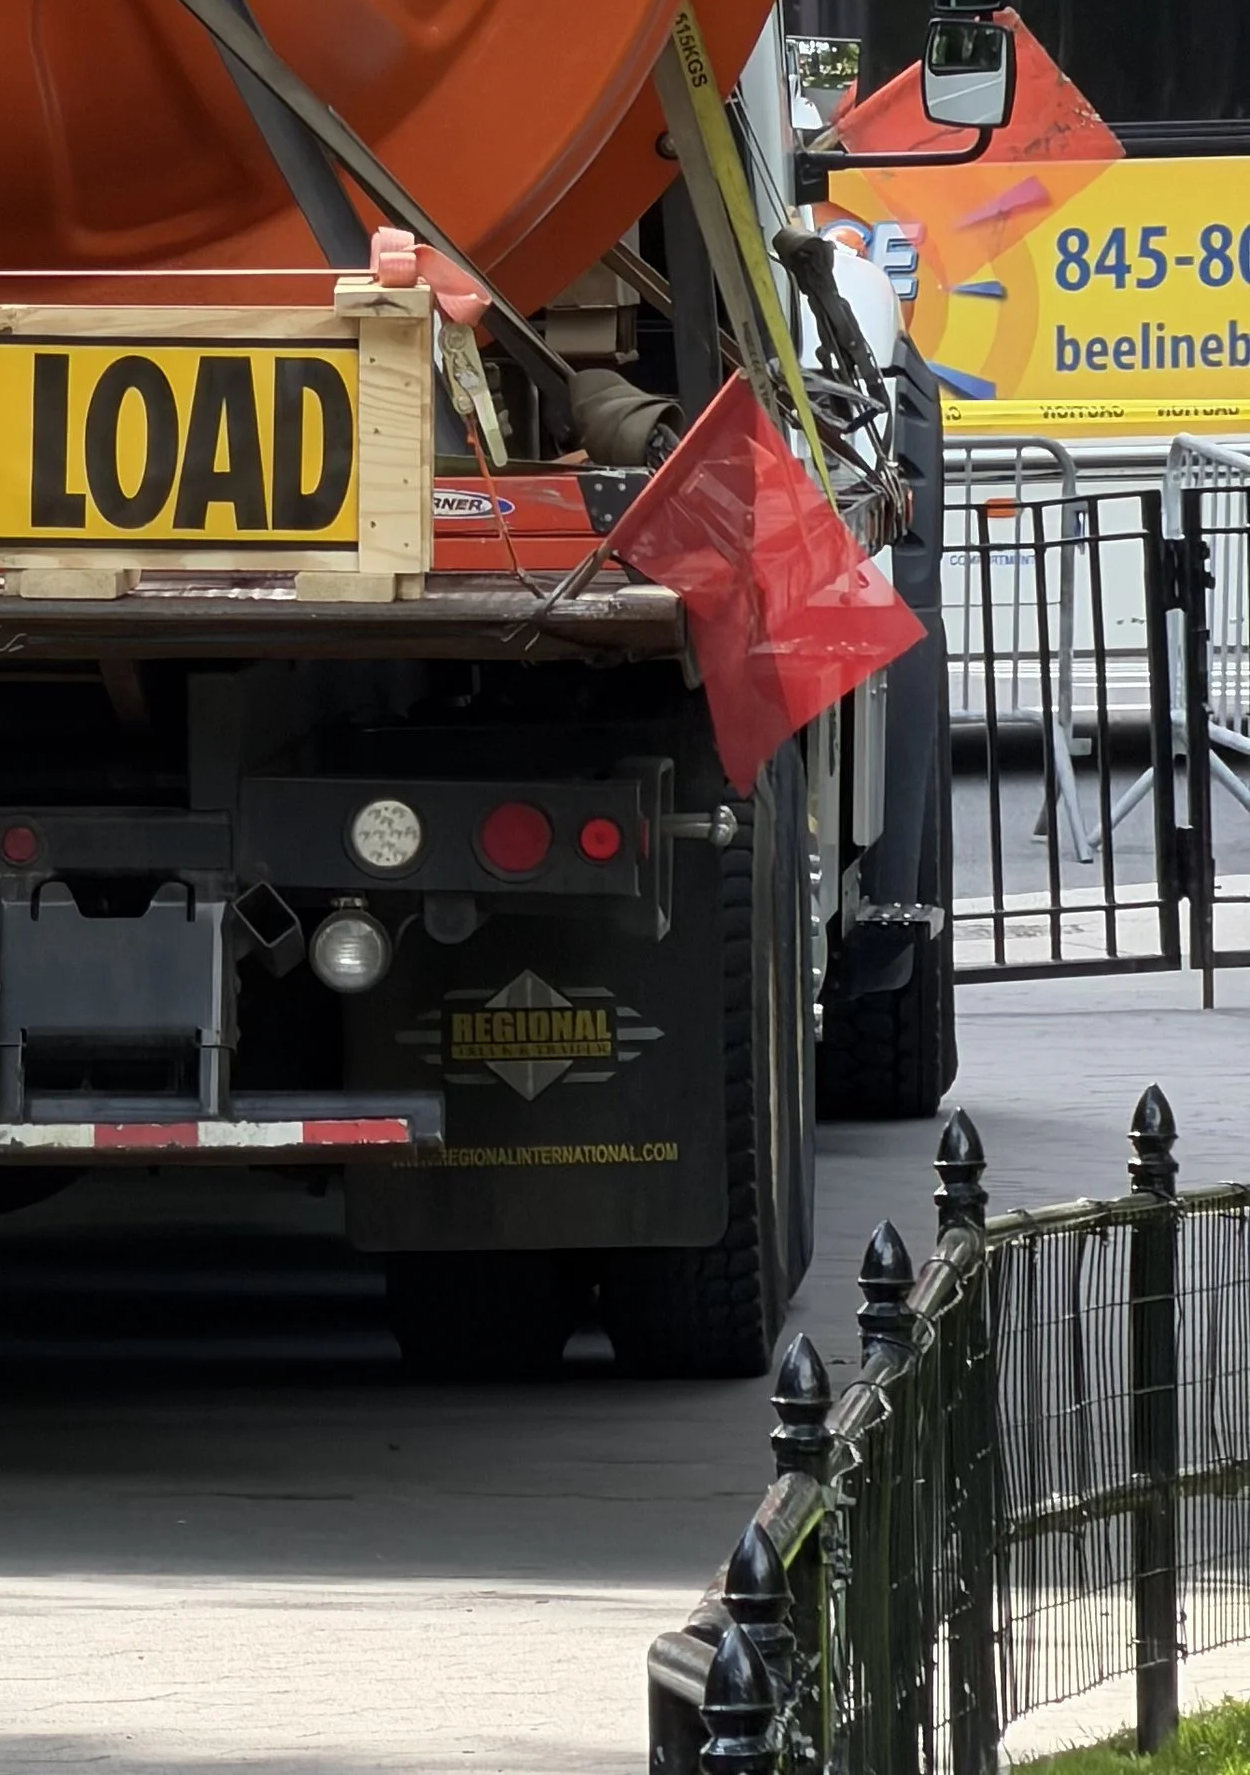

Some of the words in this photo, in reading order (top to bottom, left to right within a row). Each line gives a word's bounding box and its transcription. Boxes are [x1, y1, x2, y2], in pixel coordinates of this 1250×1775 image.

[1056, 319, 1250, 373] beelineb
[30, 352, 354, 531] LOAD
[451, 1009, 612, 1043] REGIONAL
[393, 1142, 679, 1168] REGIONALINTERNATIONAL.COM
